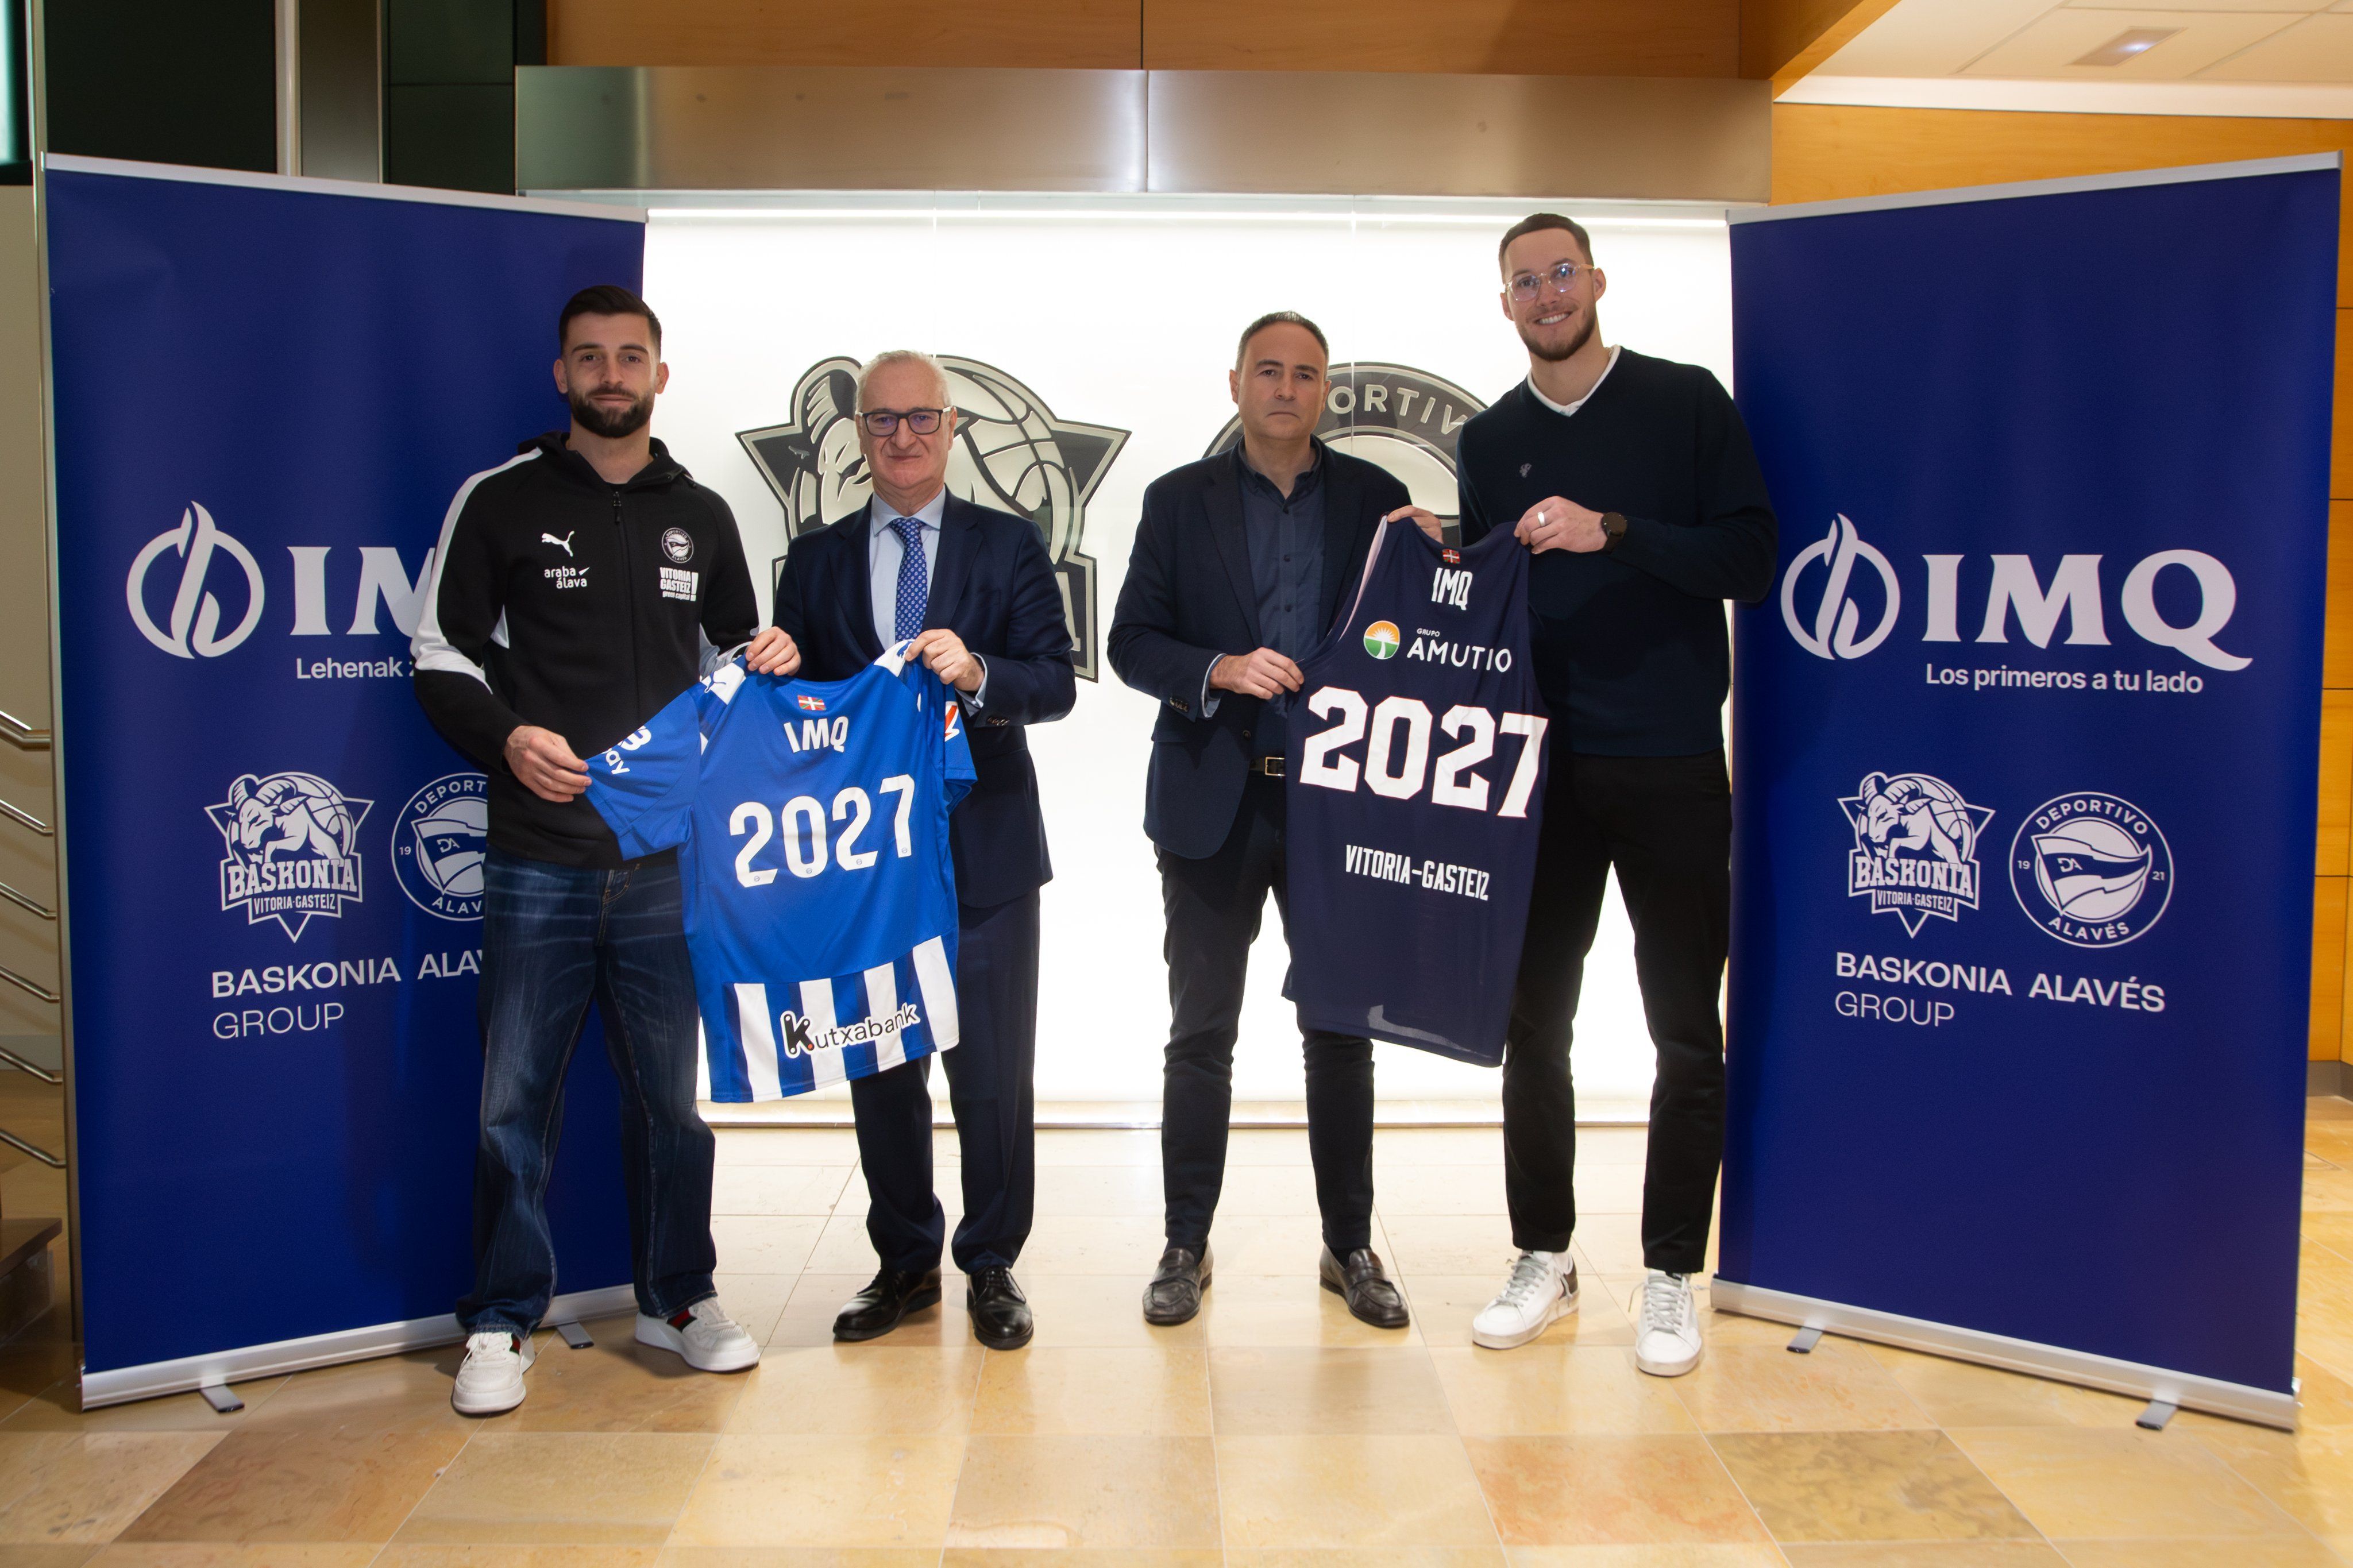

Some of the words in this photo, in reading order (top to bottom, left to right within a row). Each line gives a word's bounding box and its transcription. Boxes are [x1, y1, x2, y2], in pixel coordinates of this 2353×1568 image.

[1328, 384, 1468, 435] ORTIV
[544, 565, 576, 578] araba
[556, 576, 587, 589] álava
[659, 567, 691, 582] VITORIA
[660, 578, 691, 594] GASTEIZ
[1431, 567, 1473, 611] IMQ
[287, 546, 435, 638] IM
[1922, 549, 2253, 671] IMQ
[1416, 628, 1440, 638] GRUPO
[296, 656, 403, 679] Lehenak
[1406, 637, 1512, 673] AMUTIO
[1926, 663, 1969, 685] Los
[1974, 665, 2086, 691] primeros
[2092, 673, 2107, 690] a
[2113, 670, 2140, 691] tu
[2144, 670, 2204, 694] lado
[783, 716, 848, 753] IMQ
[1299, 686, 1548, 818] 2027
[601, 748, 630, 774] ay
[415, 780, 487, 813] DEPORT
[729, 774, 915, 888] 2027
[2035, 799, 2149, 835] DEPORTIVO
[399, 846, 411, 855] 19
[2017, 860, 2031, 870] 19
[227, 859, 357, 901] BASKONIA
[1345, 844, 1490, 901] VITORIA-GASTEIZ
[1854, 856, 1974, 898] BASKONIA
[2152, 871, 2165, 880] 21
[431, 897, 482, 914] ALAV
[2048, 917, 2130, 941] ALAVÉS
[212, 957, 402, 998] BASKONIA
[417, 949, 483, 980] ALA
[1836, 952, 2012, 995] BASKONIA
[2028, 973, 2165, 1012] ALAVÉS
[213, 1002, 345, 1040] GROUP
[1834, 991, 1955, 1028] GROUP
[784, 1003, 916, 1055] Kutxabank
